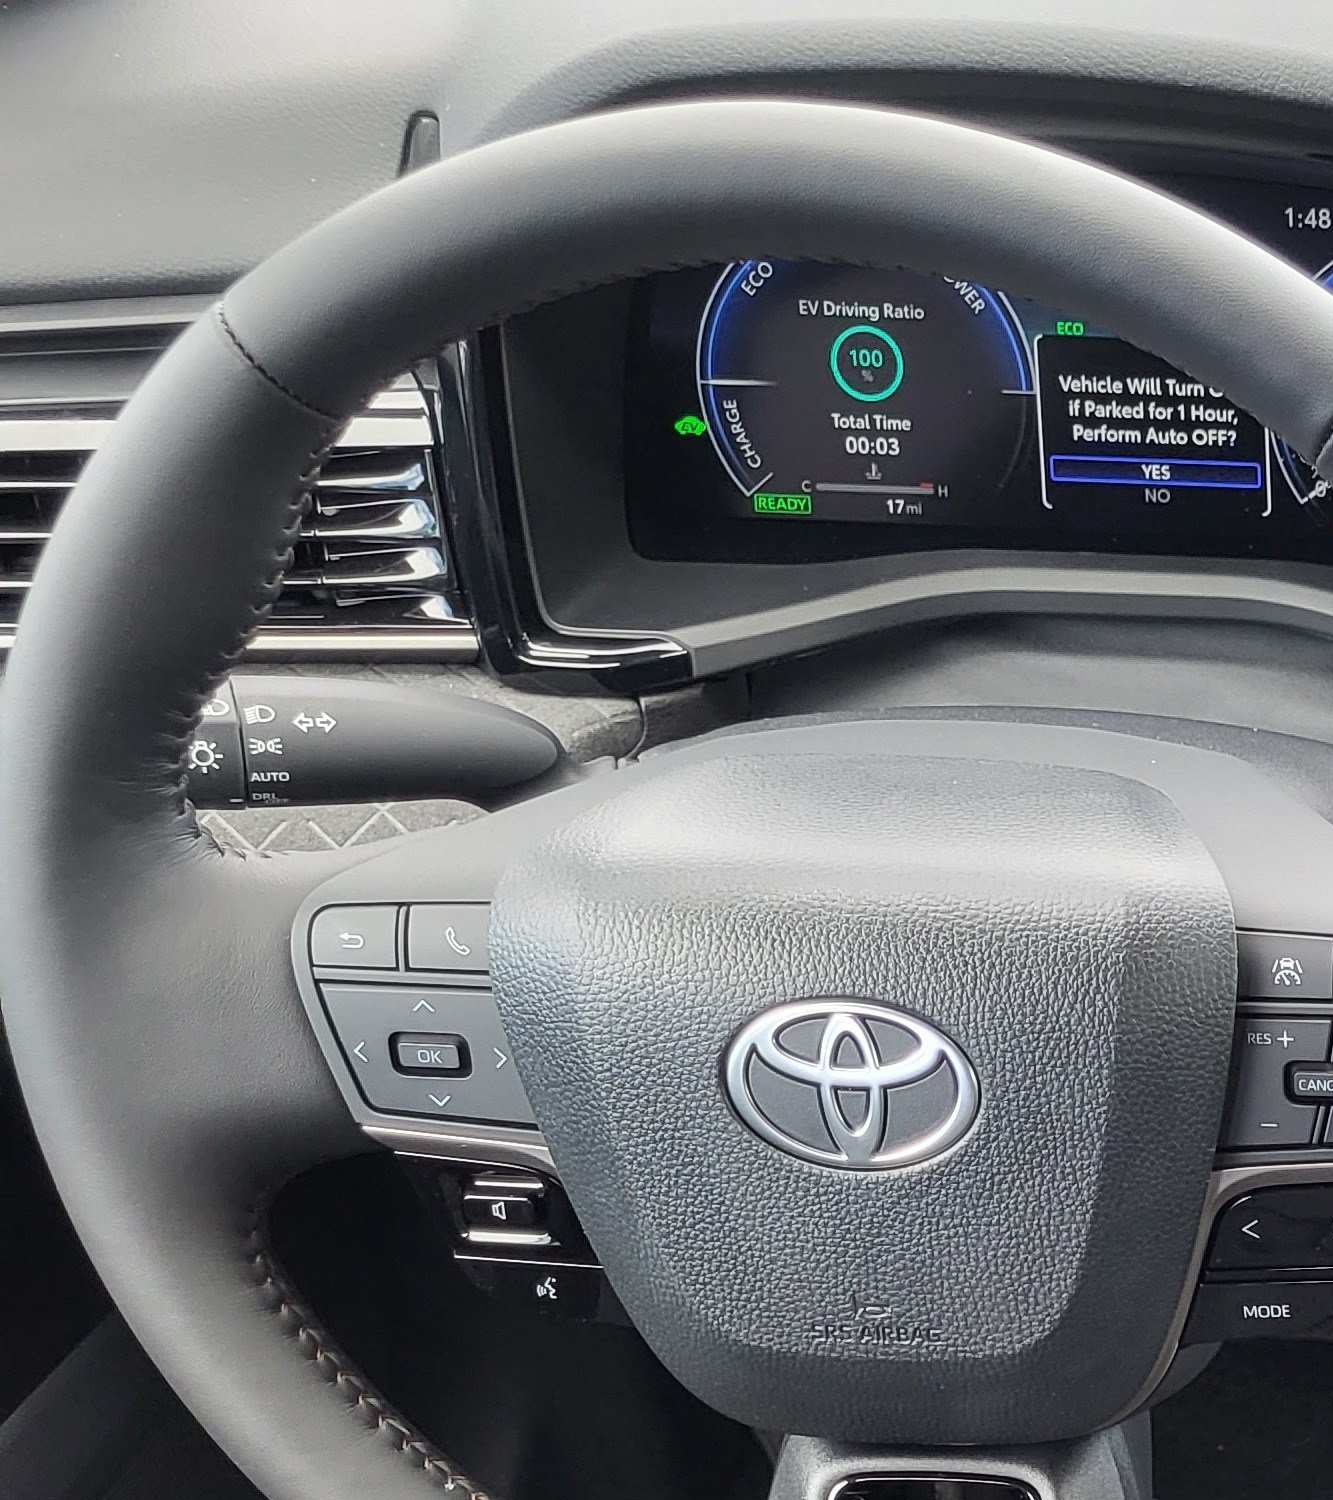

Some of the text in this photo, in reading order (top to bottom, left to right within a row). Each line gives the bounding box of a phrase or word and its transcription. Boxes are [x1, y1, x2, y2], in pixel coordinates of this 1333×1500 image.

[1285, 208, 1331, 229] 1:48
[740, 262, 774, 296] ECO
[943, 275, 986, 315] WER
[799, 300, 925, 321] EV Driving Ratio
[1056, 322, 1084, 336] ECO
[849, 349, 883, 369] 100
[1059, 376, 1122, 396] Vehicle
[1127, 377, 1161, 395] Will
[1166, 380, 1204, 398] Turn
[1069, 401, 1238, 426] if Parked for 1 Hour,
[831, 413, 911, 432] Total Time
[723, 399, 761, 468] CHARGE
[1072, 425, 1237, 447] Perform Auto OFF?
[845, 437, 900, 456] 00:03
[1141, 465, 1171, 481] YES
[802, 481, 811, 492] C
[938, 485, 949, 498] H
[758, 496, 807, 511] READY
[1145, 488, 1170, 504] NO
[251, 772, 290, 782] AUTO
[252, 793, 278, 801] DRL
[1247, 1032, 1272, 1045] RES
[417, 1049, 443, 1065] OK
[1243, 1304, 1291, 1319] MODE
